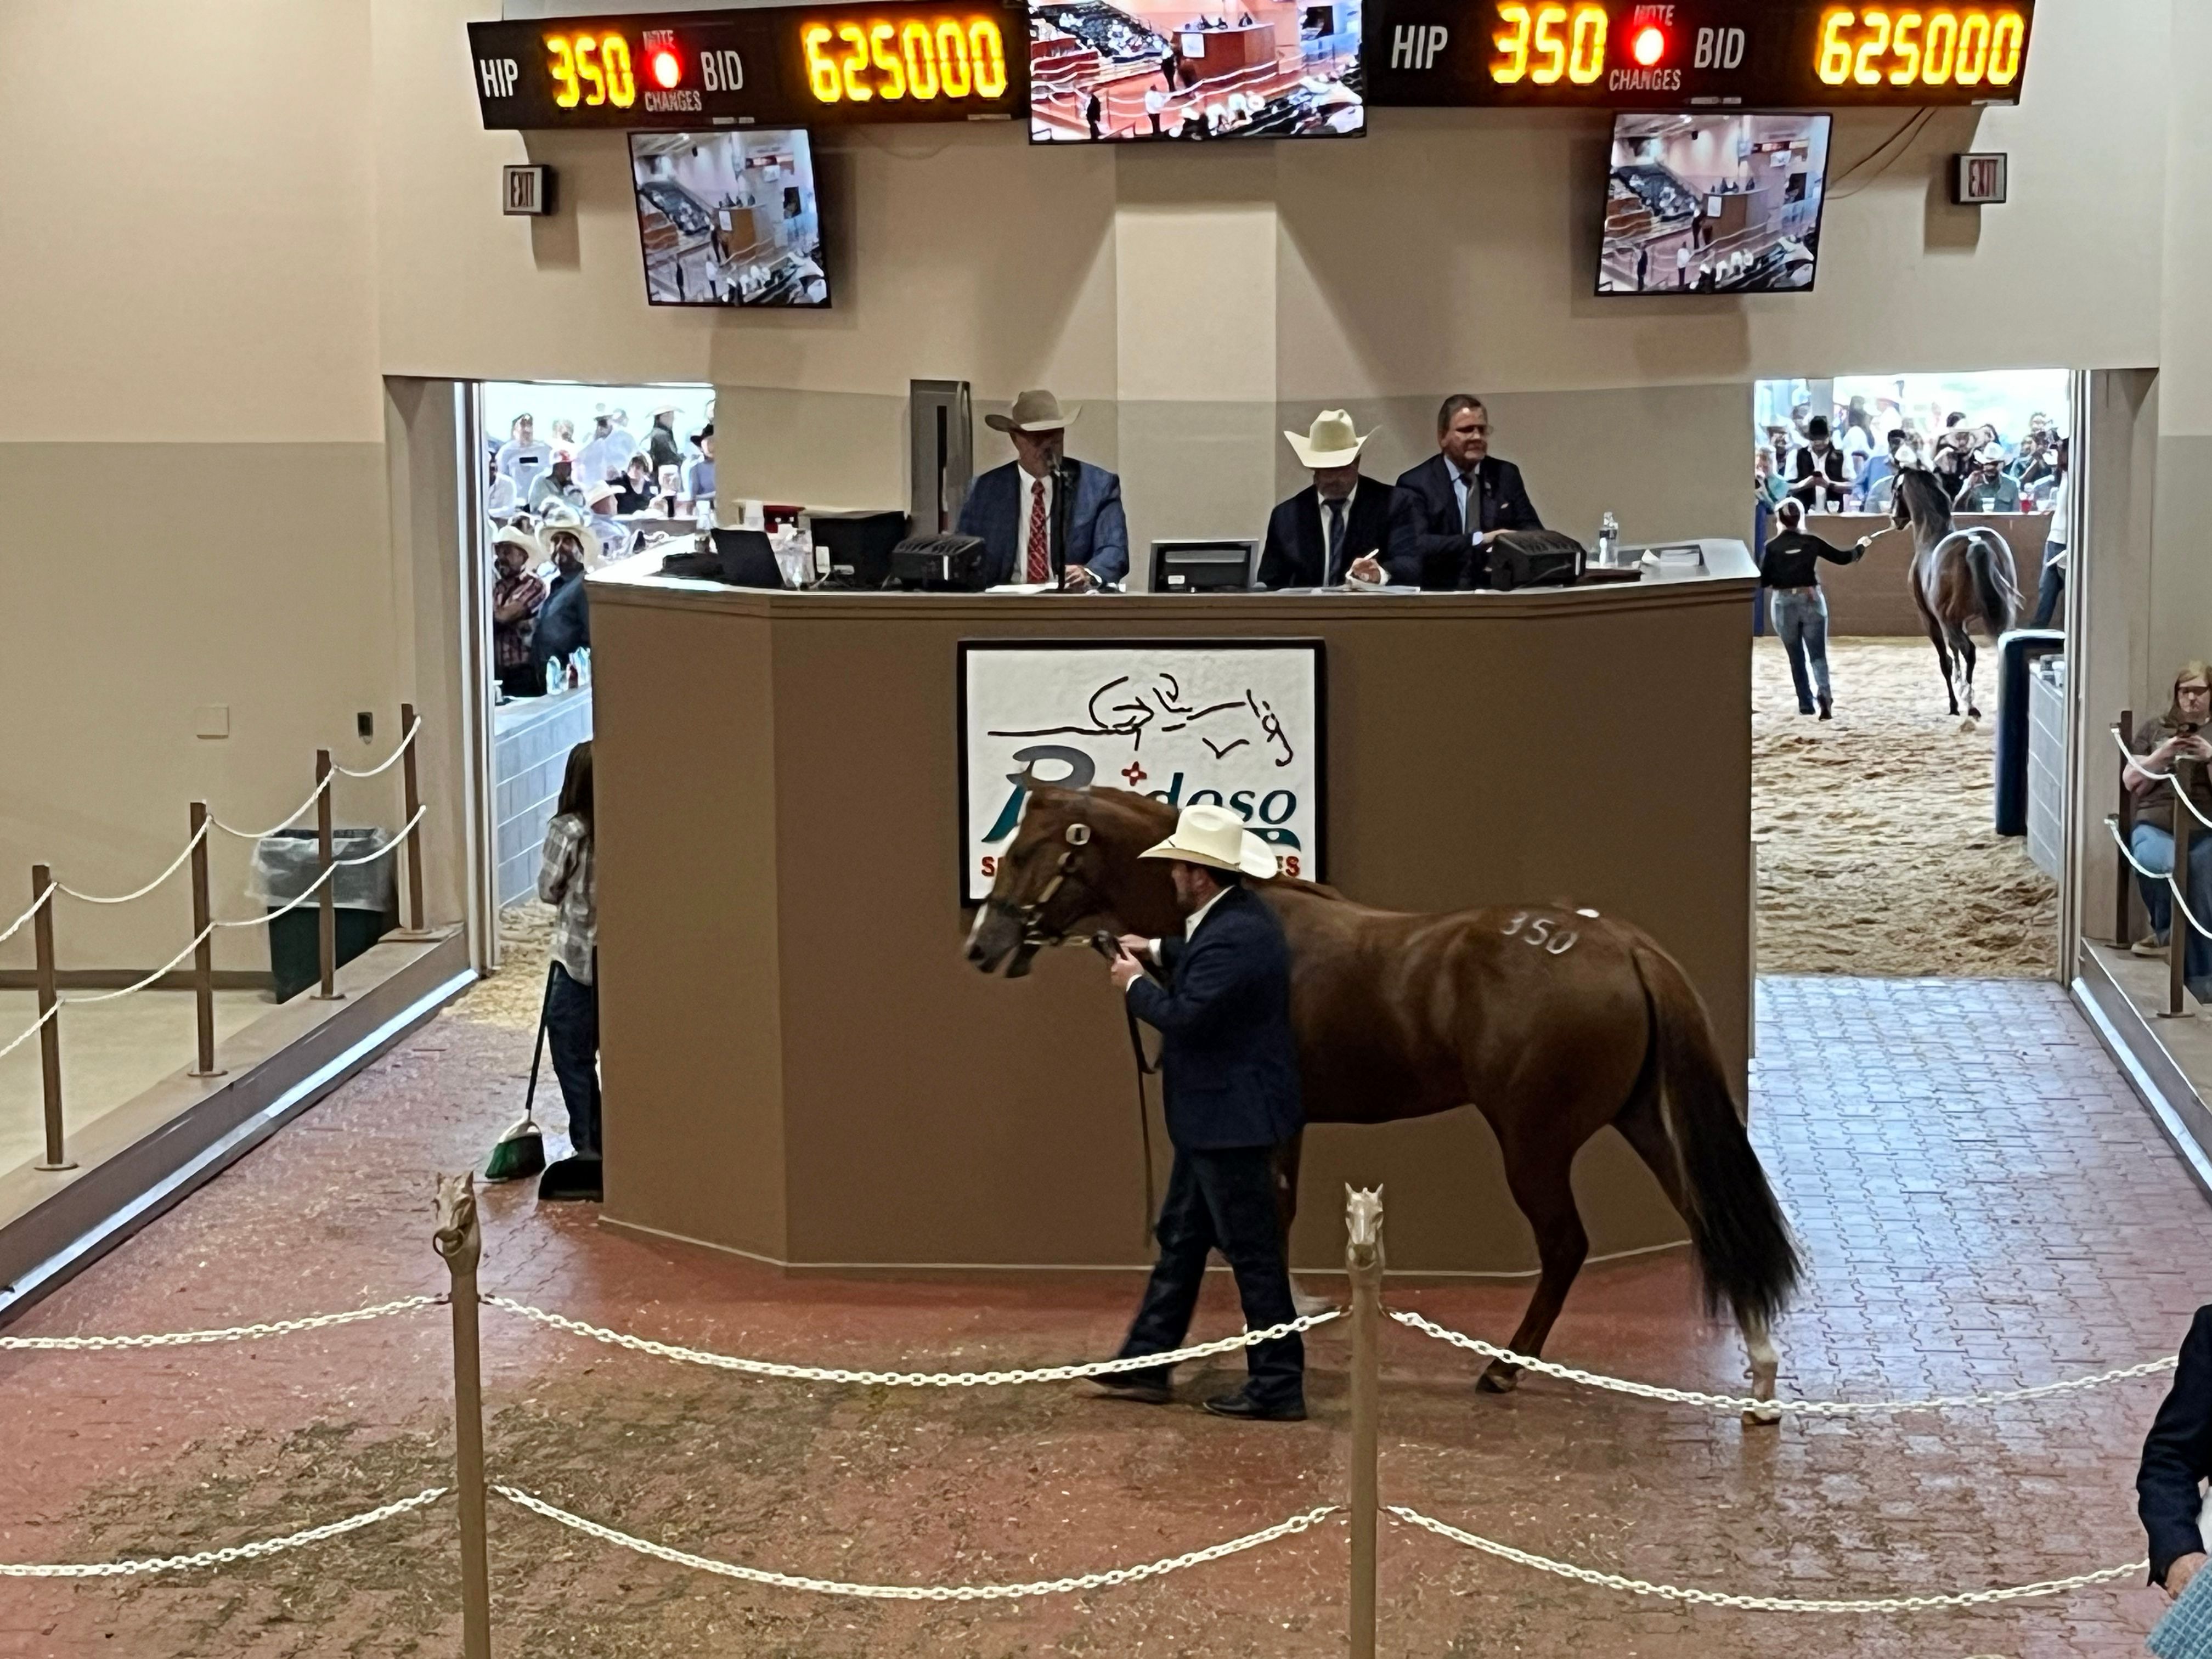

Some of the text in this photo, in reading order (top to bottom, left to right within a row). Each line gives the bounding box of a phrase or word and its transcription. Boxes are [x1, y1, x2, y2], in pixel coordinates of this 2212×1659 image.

[479, 36, 636, 108] HIP 350
[701, 20, 1007, 103] BID 625000
[1391, 7, 1608, 84] HIP 350
[1609, 68, 1681, 92] CHANGES
[1694, 12, 2025, 86] BID 625000
[644, 90, 702, 112] CHANGES
[1501, 911, 1578, 955] 350
